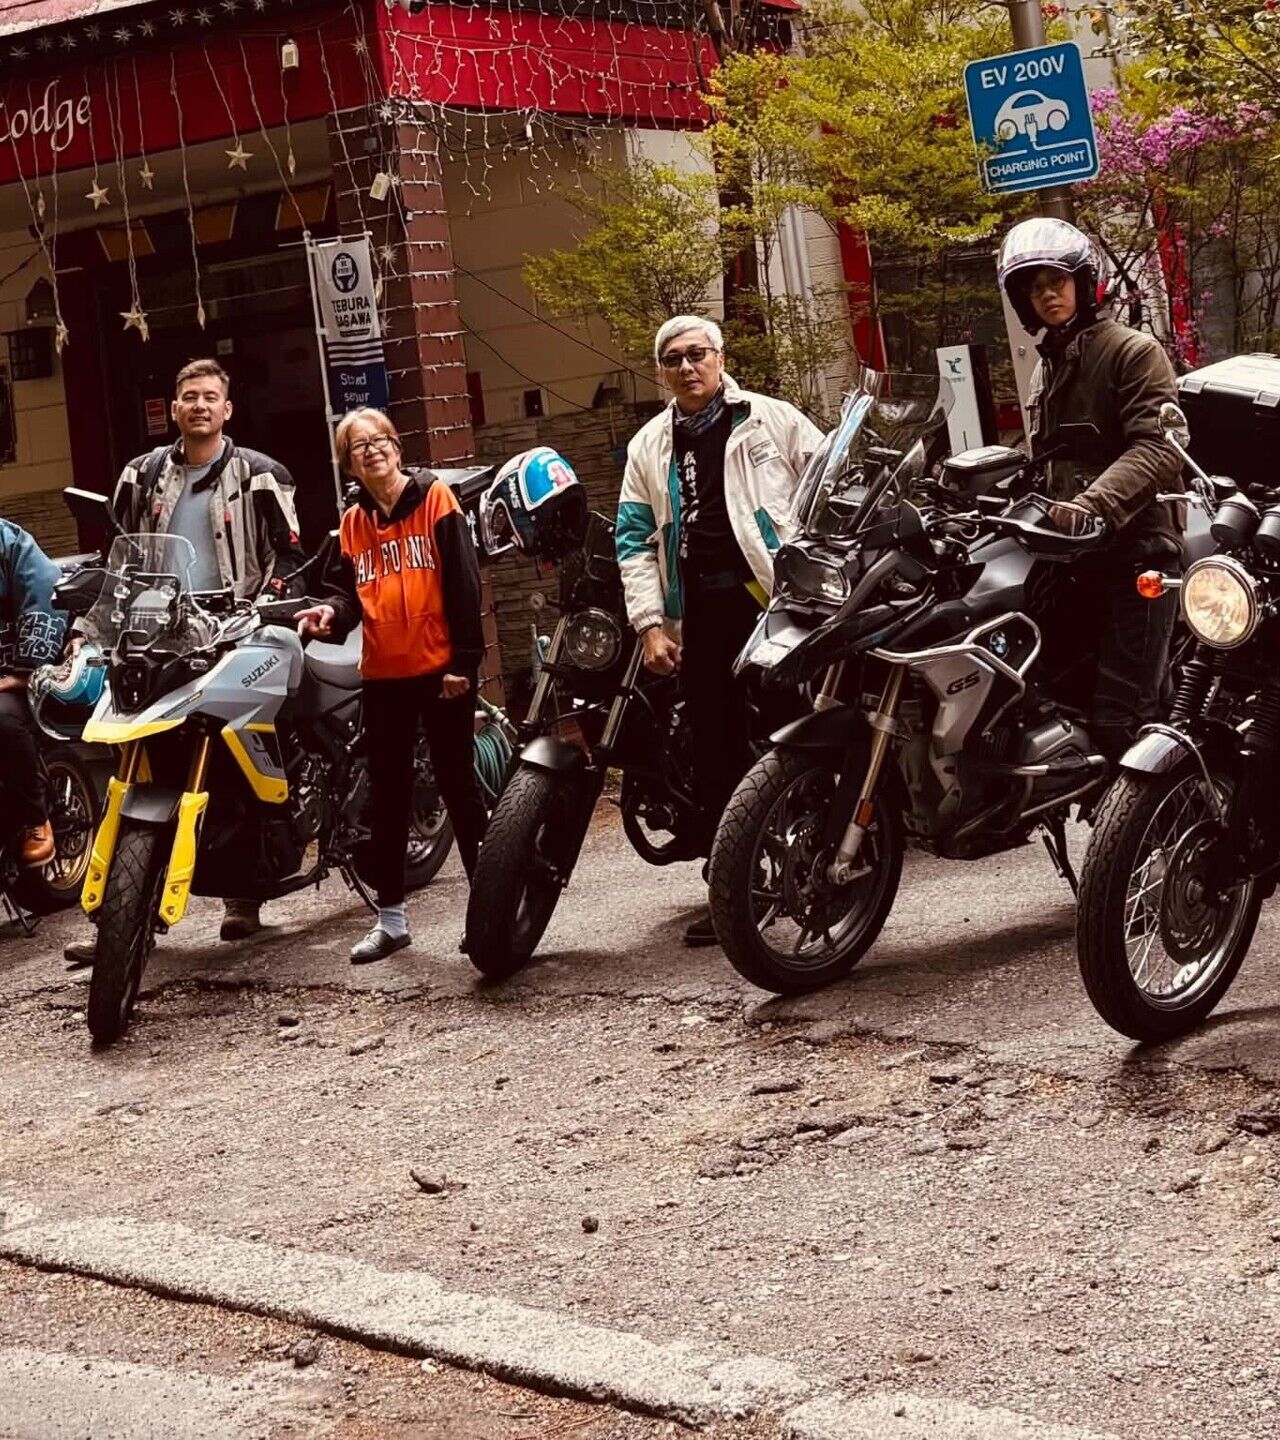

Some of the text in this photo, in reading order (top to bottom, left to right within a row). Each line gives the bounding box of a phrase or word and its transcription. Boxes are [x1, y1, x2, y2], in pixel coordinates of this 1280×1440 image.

[980, 53, 1065, 89] EV 200V
[988, 149, 1086, 178] CHARGING POINT
[331, 295, 371, 313] TEBURA
[353, 535, 436, 585] ALFONIA
[241, 654, 280, 688] SUZUKI
[946, 669, 980, 695] GS
